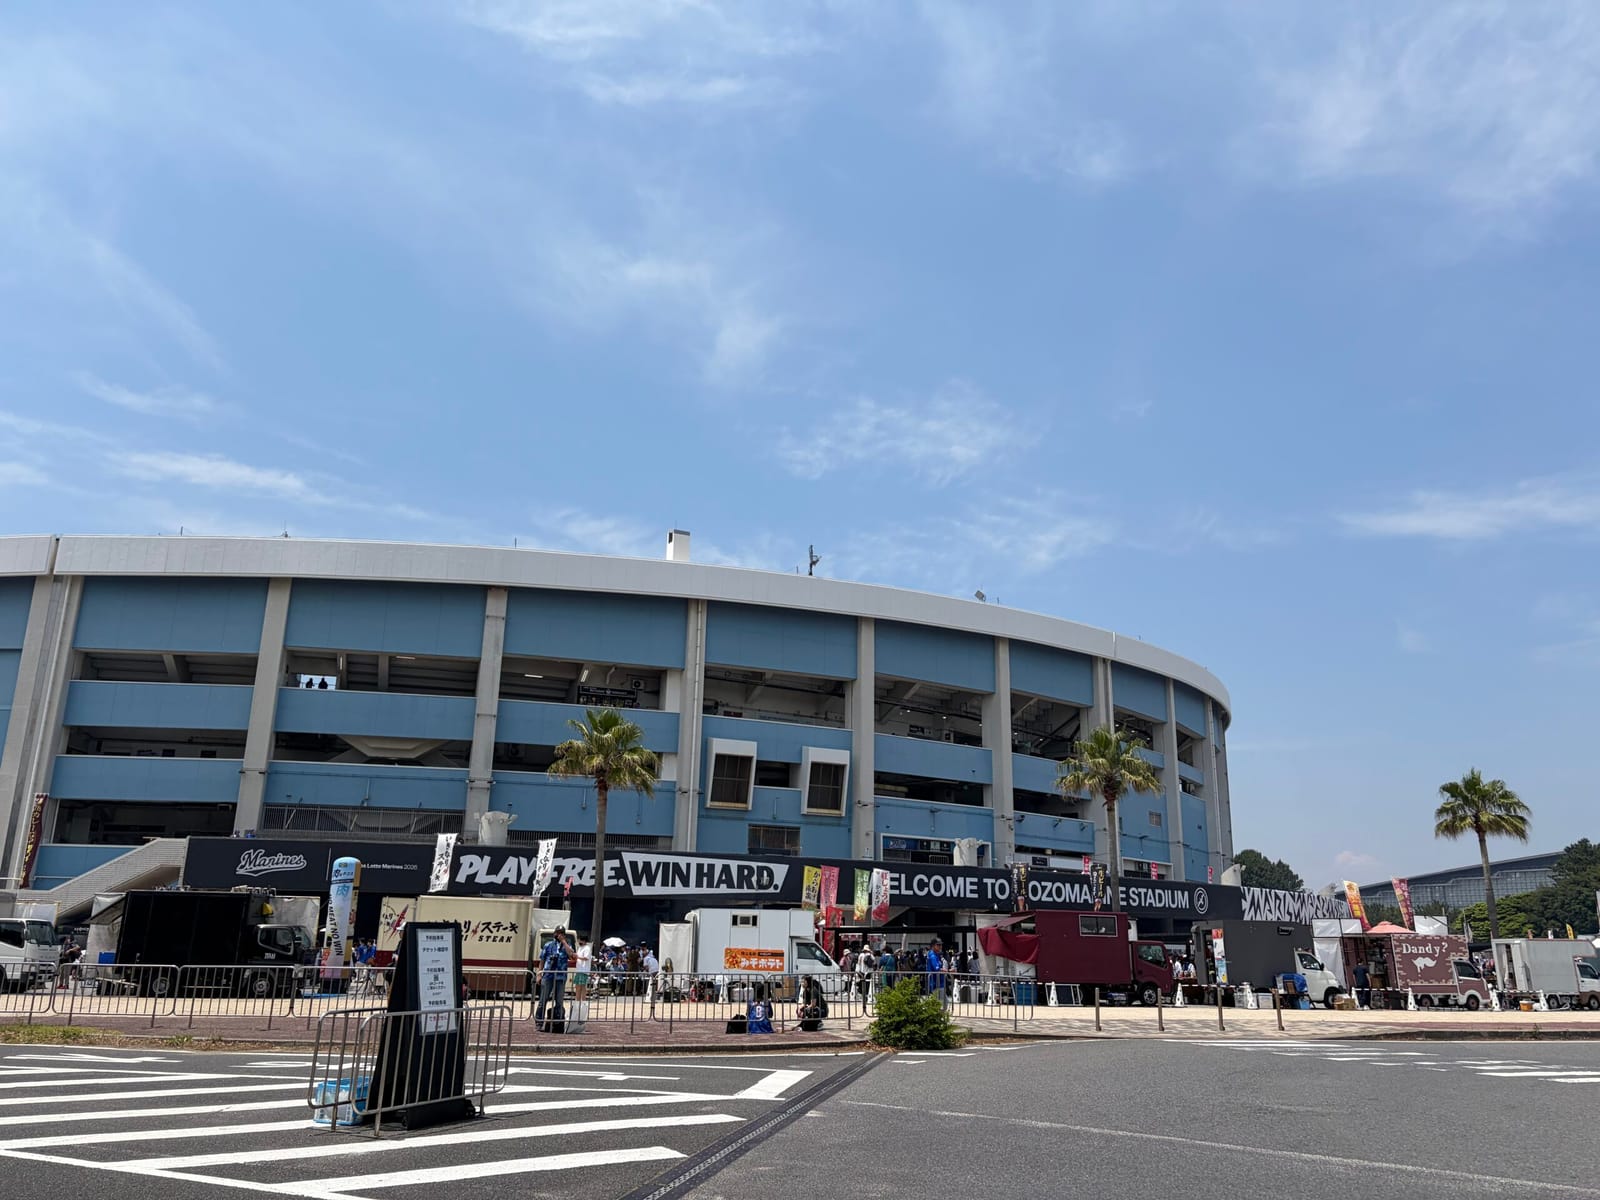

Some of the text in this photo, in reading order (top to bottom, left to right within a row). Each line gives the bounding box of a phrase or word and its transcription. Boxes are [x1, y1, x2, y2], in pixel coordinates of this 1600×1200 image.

[236, 849, 307, 876] Marines
[455, 854, 538, 885] PLAY
[629, 860, 779, 891] WIN HARD.
[868, 872, 979, 898] ELCOME
[983, 878, 1010, 900] TO
[1129, 887, 1190, 909] STADIUM
[328, 907, 336, 926] MEAT
[330, 928, 340, 939] NO
[481, 921, 519, 934] ステーキ
[478, 935, 513, 943] STEAK
[333, 941, 344, 956] WIN
[1402, 942, 1448, 957] Dandy?
